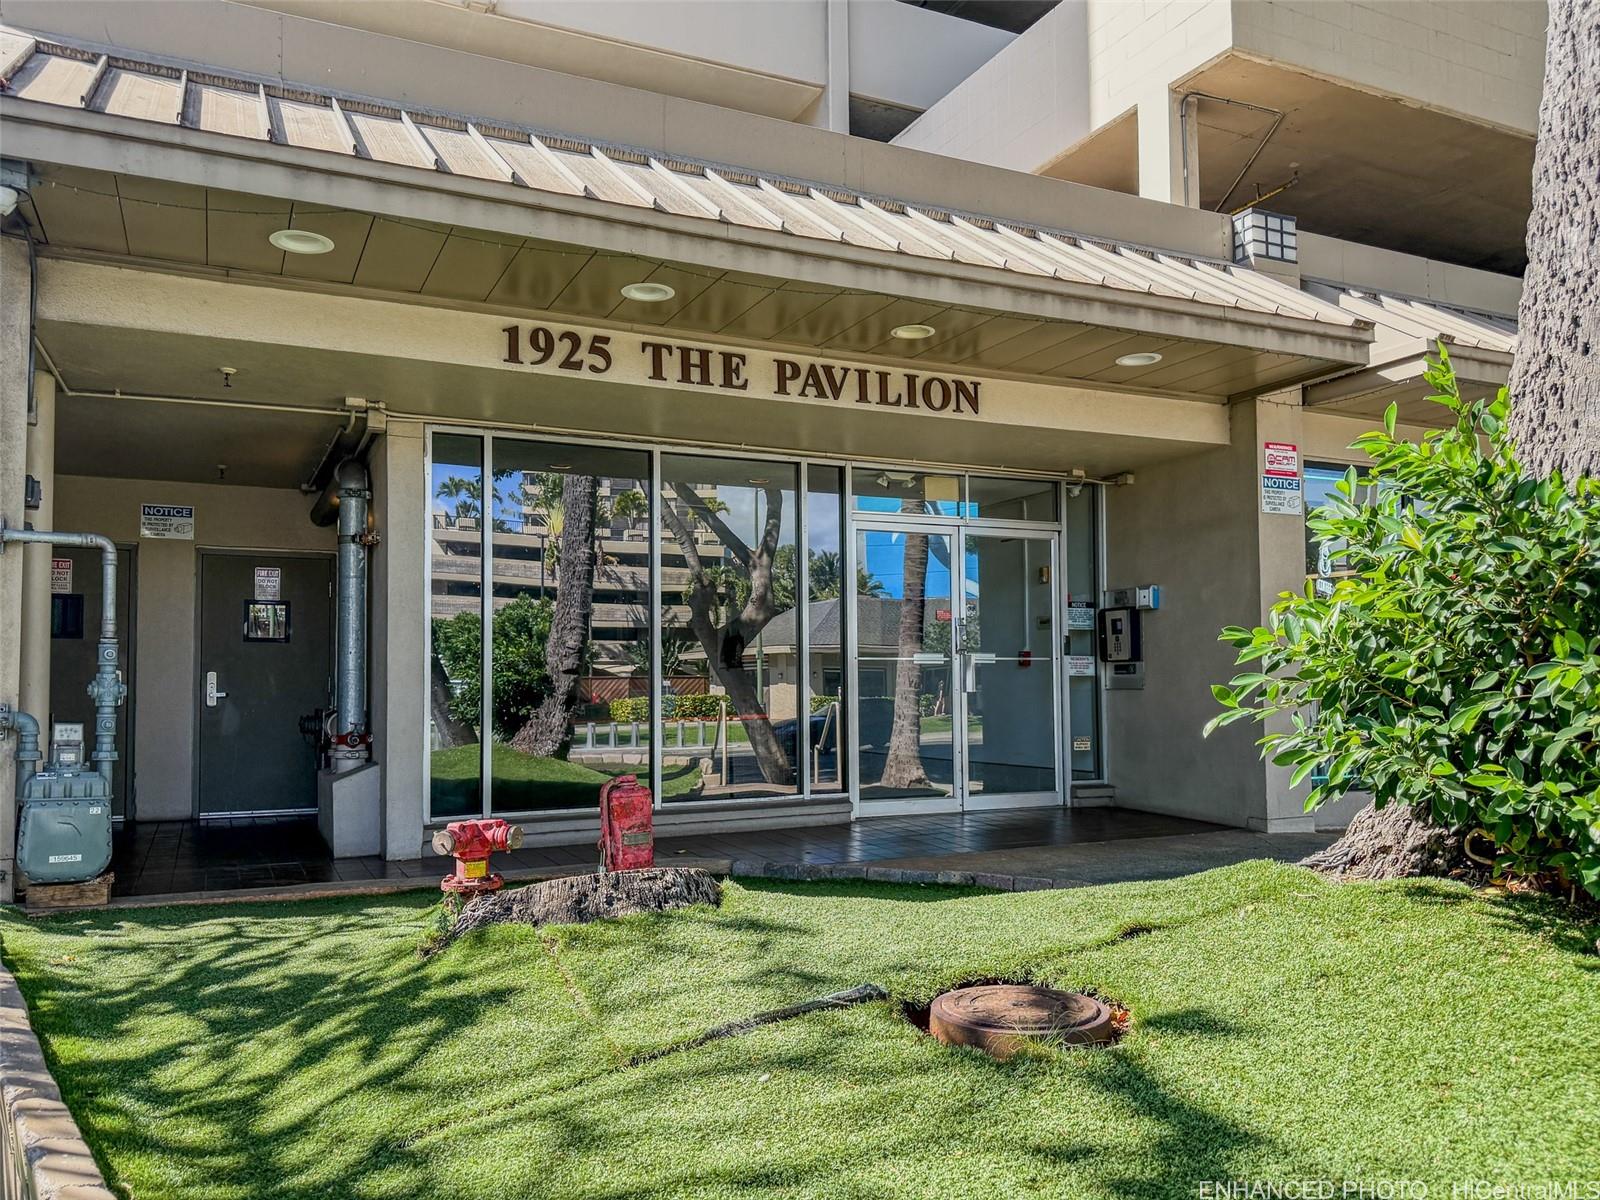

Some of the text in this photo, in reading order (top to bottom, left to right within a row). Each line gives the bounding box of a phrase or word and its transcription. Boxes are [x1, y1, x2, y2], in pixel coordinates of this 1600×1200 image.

[502, 324, 982, 415] 1925 THE PAVILION
[1264, 478, 1299, 490] NOTICE
[144, 506, 191, 517] NOTICE
